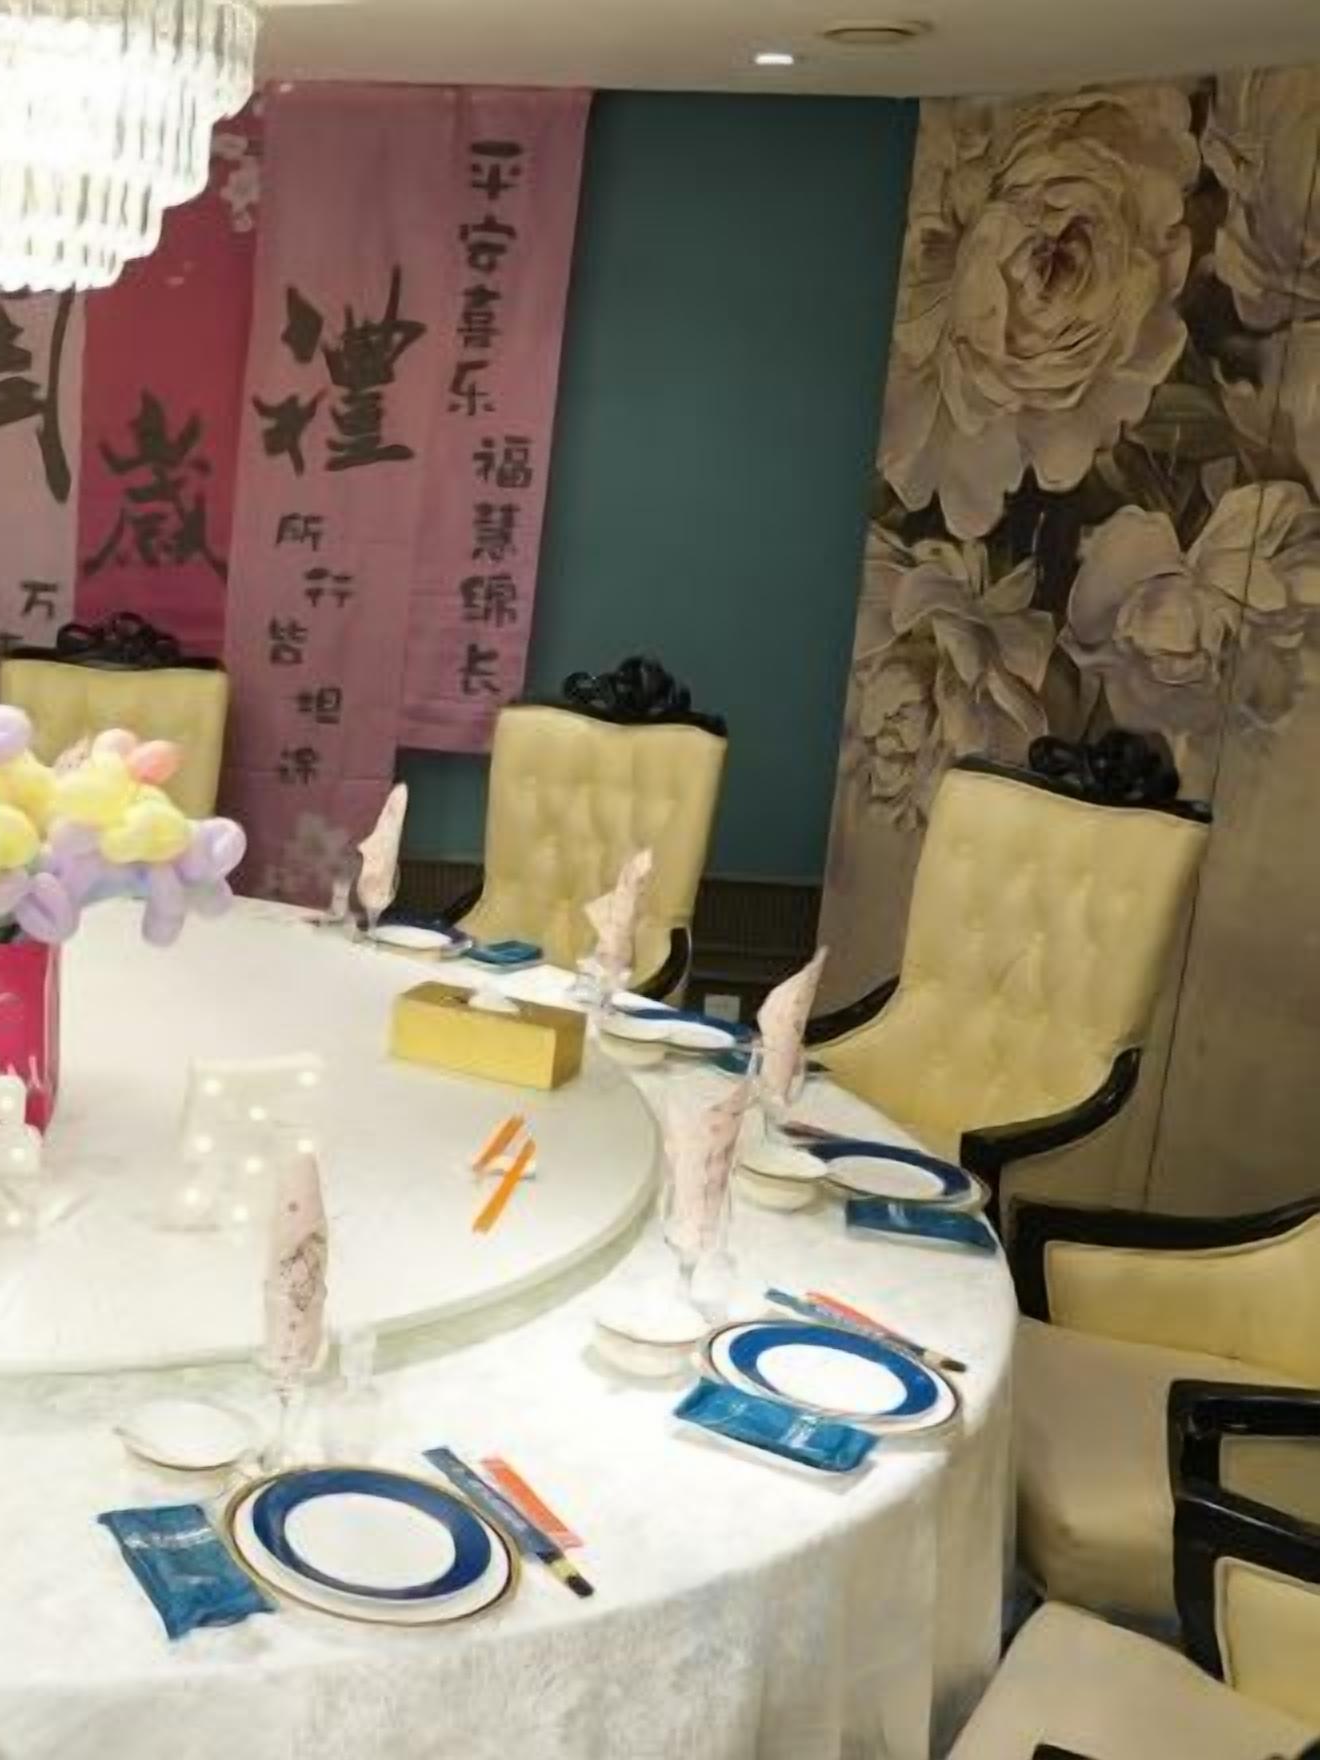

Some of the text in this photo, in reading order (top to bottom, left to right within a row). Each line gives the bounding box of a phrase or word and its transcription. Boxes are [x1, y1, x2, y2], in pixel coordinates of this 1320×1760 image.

[447, 140, 534, 697] 平安喜乐 福慧绵长
